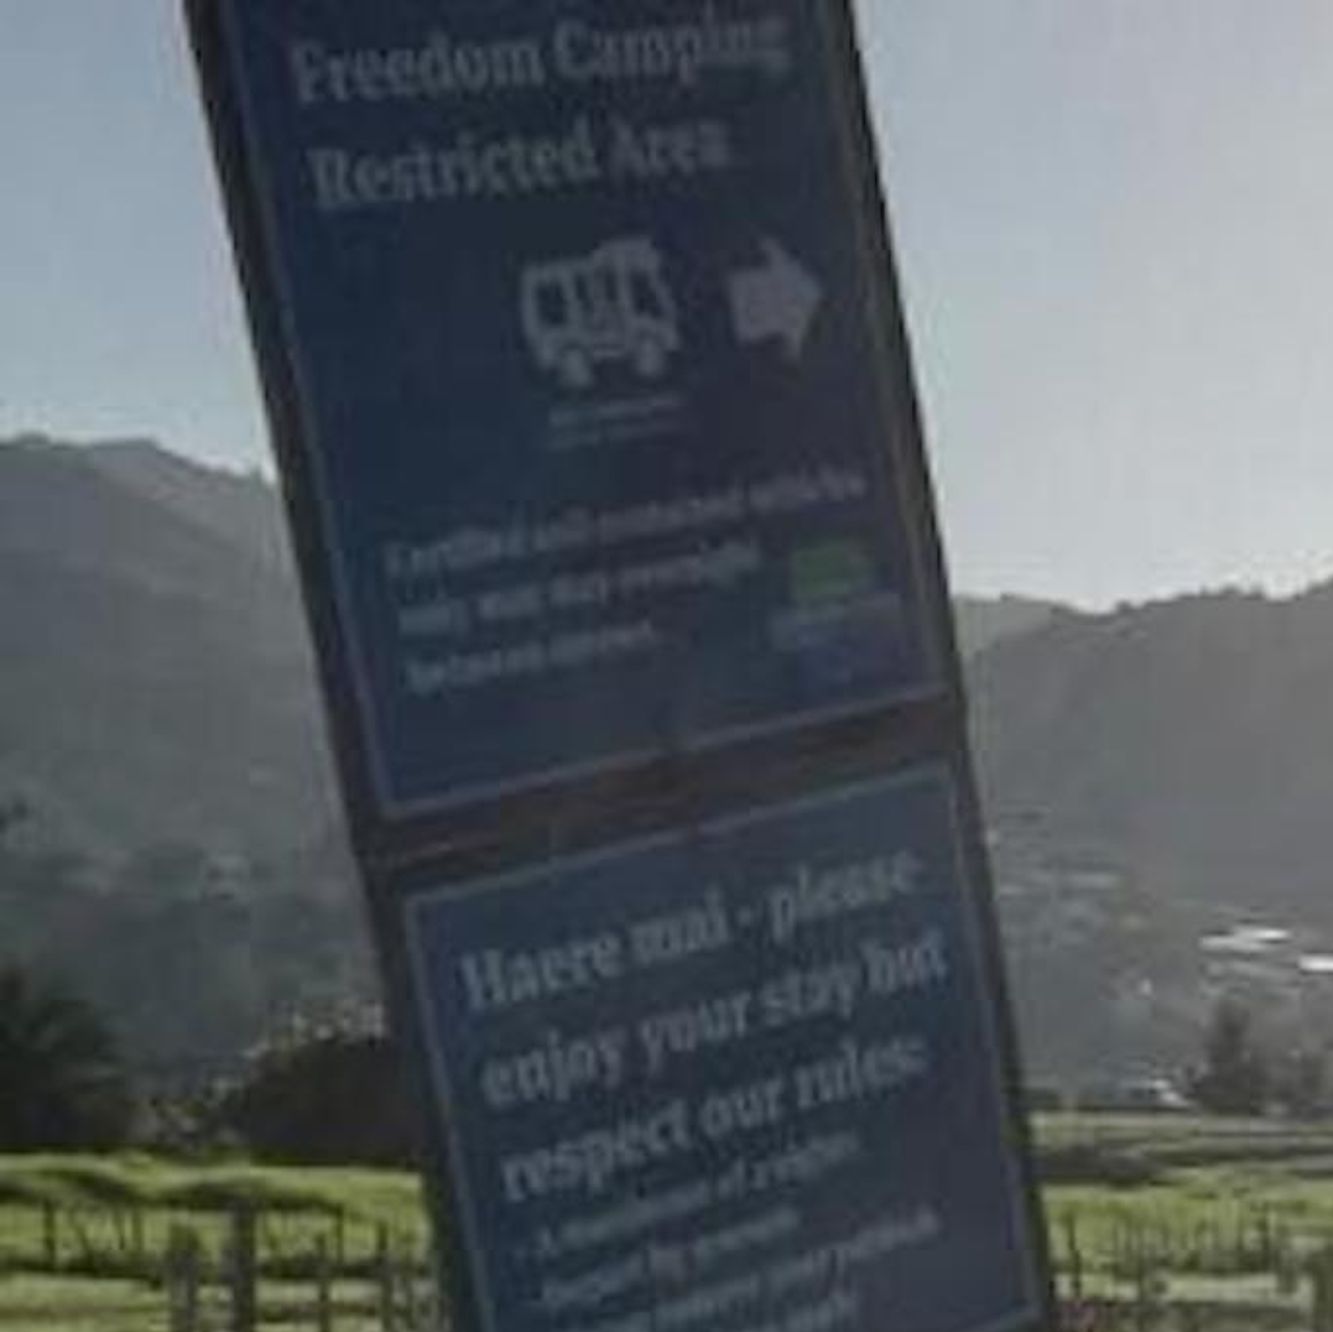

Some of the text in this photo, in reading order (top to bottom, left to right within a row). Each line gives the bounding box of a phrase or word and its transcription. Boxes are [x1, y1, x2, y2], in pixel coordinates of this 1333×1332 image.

[292, 8, 792, 104] Freedom Camping
[305, 114, 730, 209] Restricted Area
[462, 932, 620, 1011] Haere
[630, 884, 730, 966] mai
[769, 850, 927, 944] please
[480, 927, 948, 1106] enjoy your stay but
[502, 1100, 690, 1203] respect
[700, 1078, 785, 1138] our
